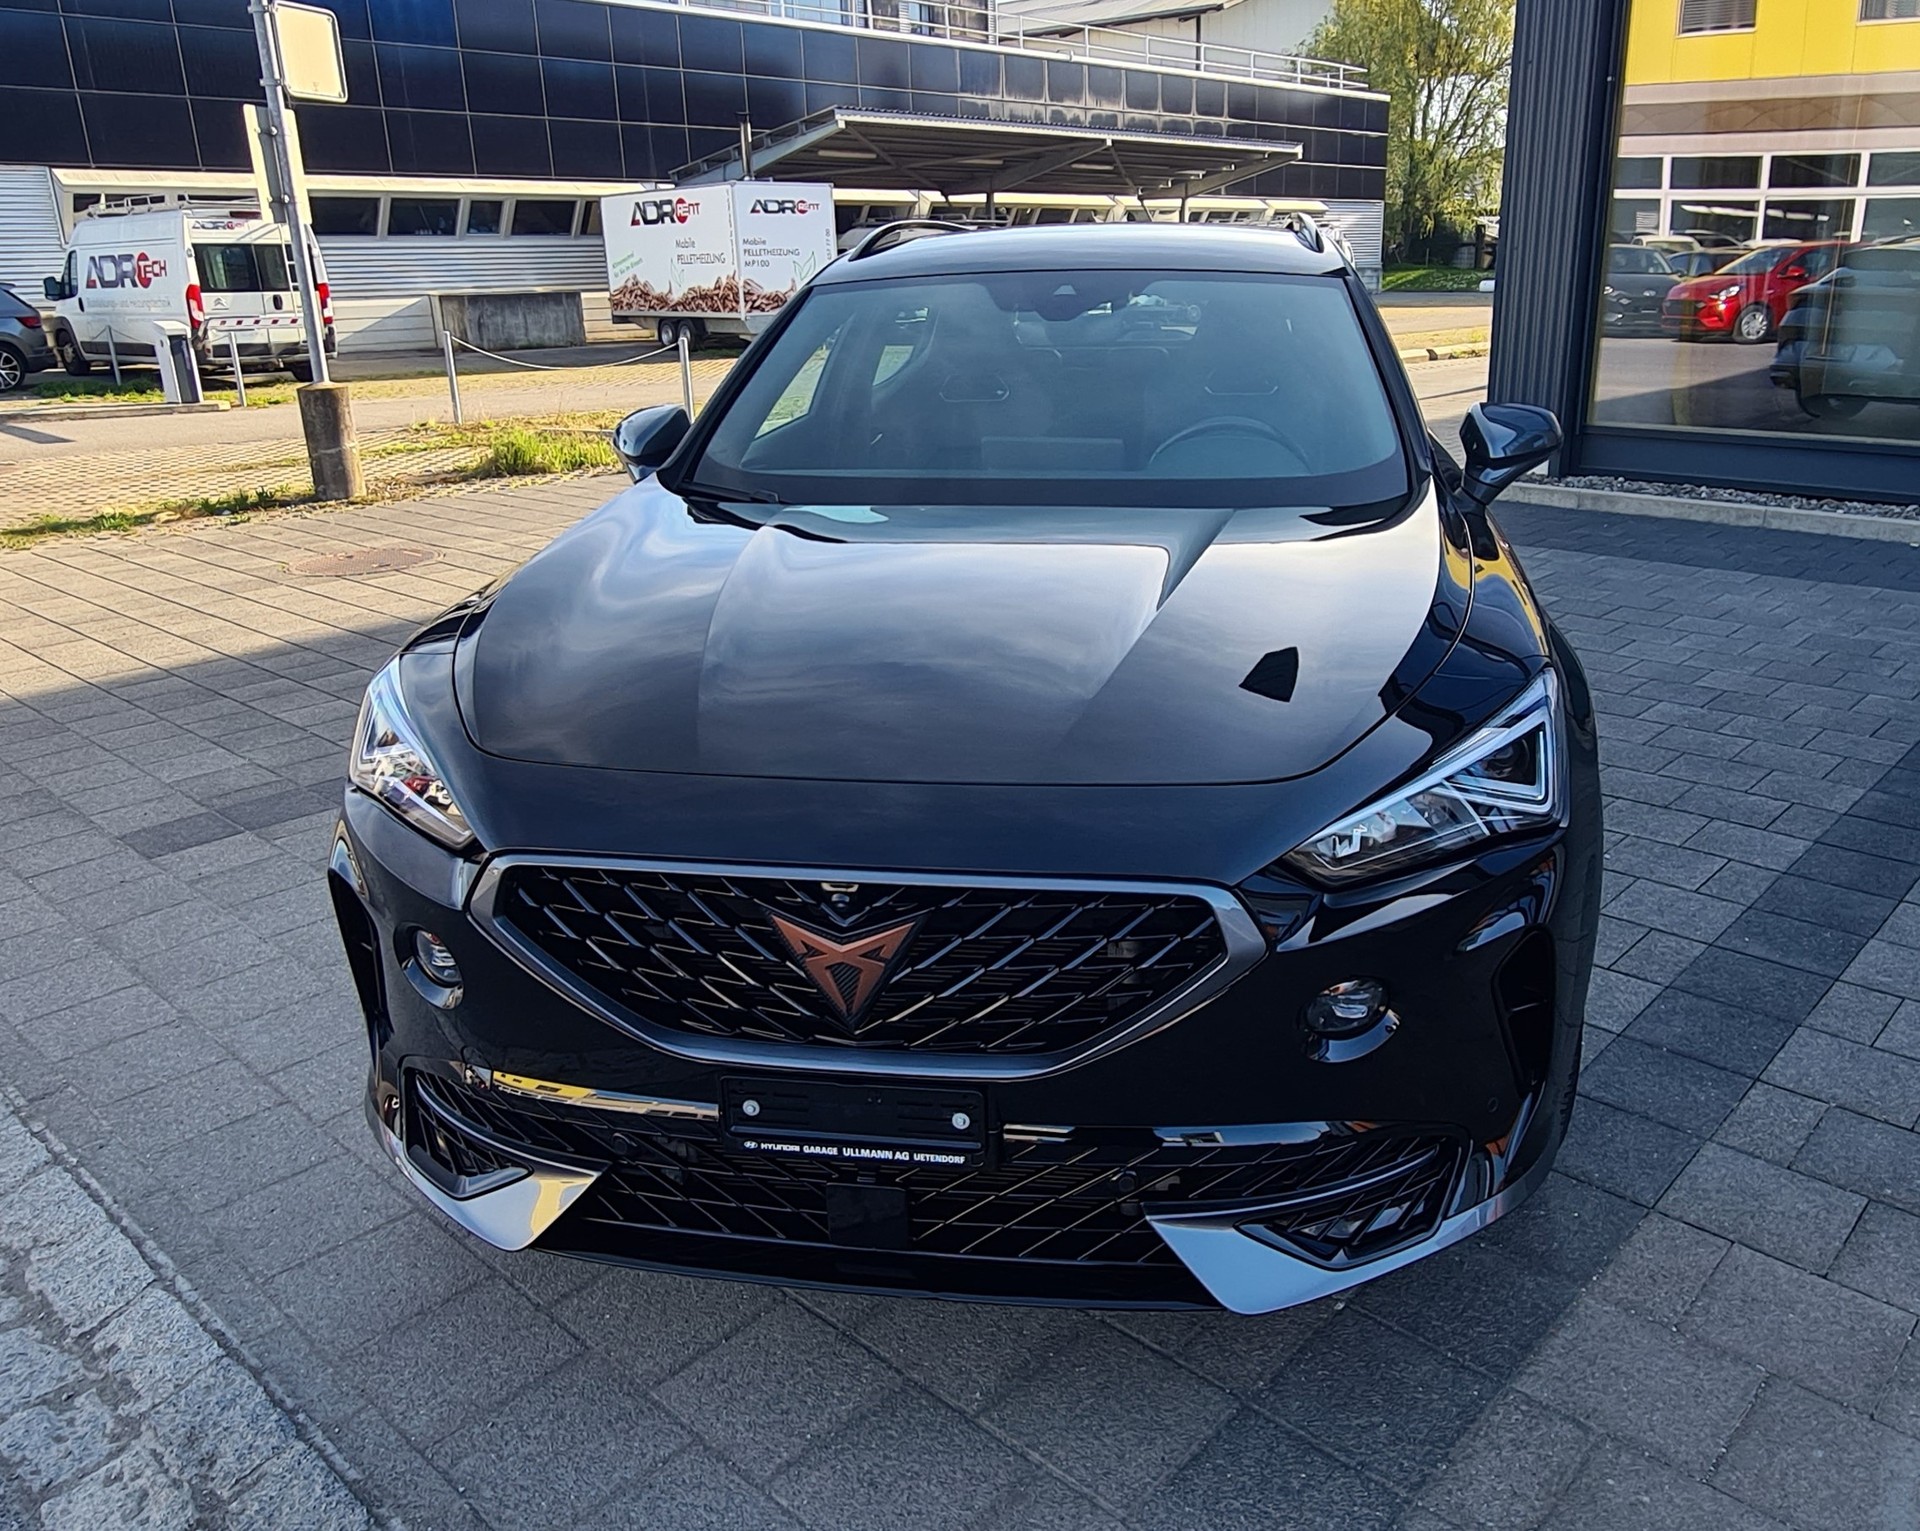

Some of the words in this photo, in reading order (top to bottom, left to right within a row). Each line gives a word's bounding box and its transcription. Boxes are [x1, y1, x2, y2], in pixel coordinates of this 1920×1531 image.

[675, 237, 696, 249] Mobile
[742, 237, 767, 246] Mobile
[677, 252, 726, 265] PELLETHEIZUNG
[743, 248, 800, 257] PELLETHEIZUNG
[744, 259, 770, 268] MP100
[86, 254, 139, 289] ADR
[760, 1142, 800, 1152] HYUNDAI
[803, 1145, 839, 1156] GARAGE
[843, 1147, 893, 1160] ULLMANN
[894, 1151, 910, 1161] AG
[913, 1153, 966, 1164] UETENDORF
